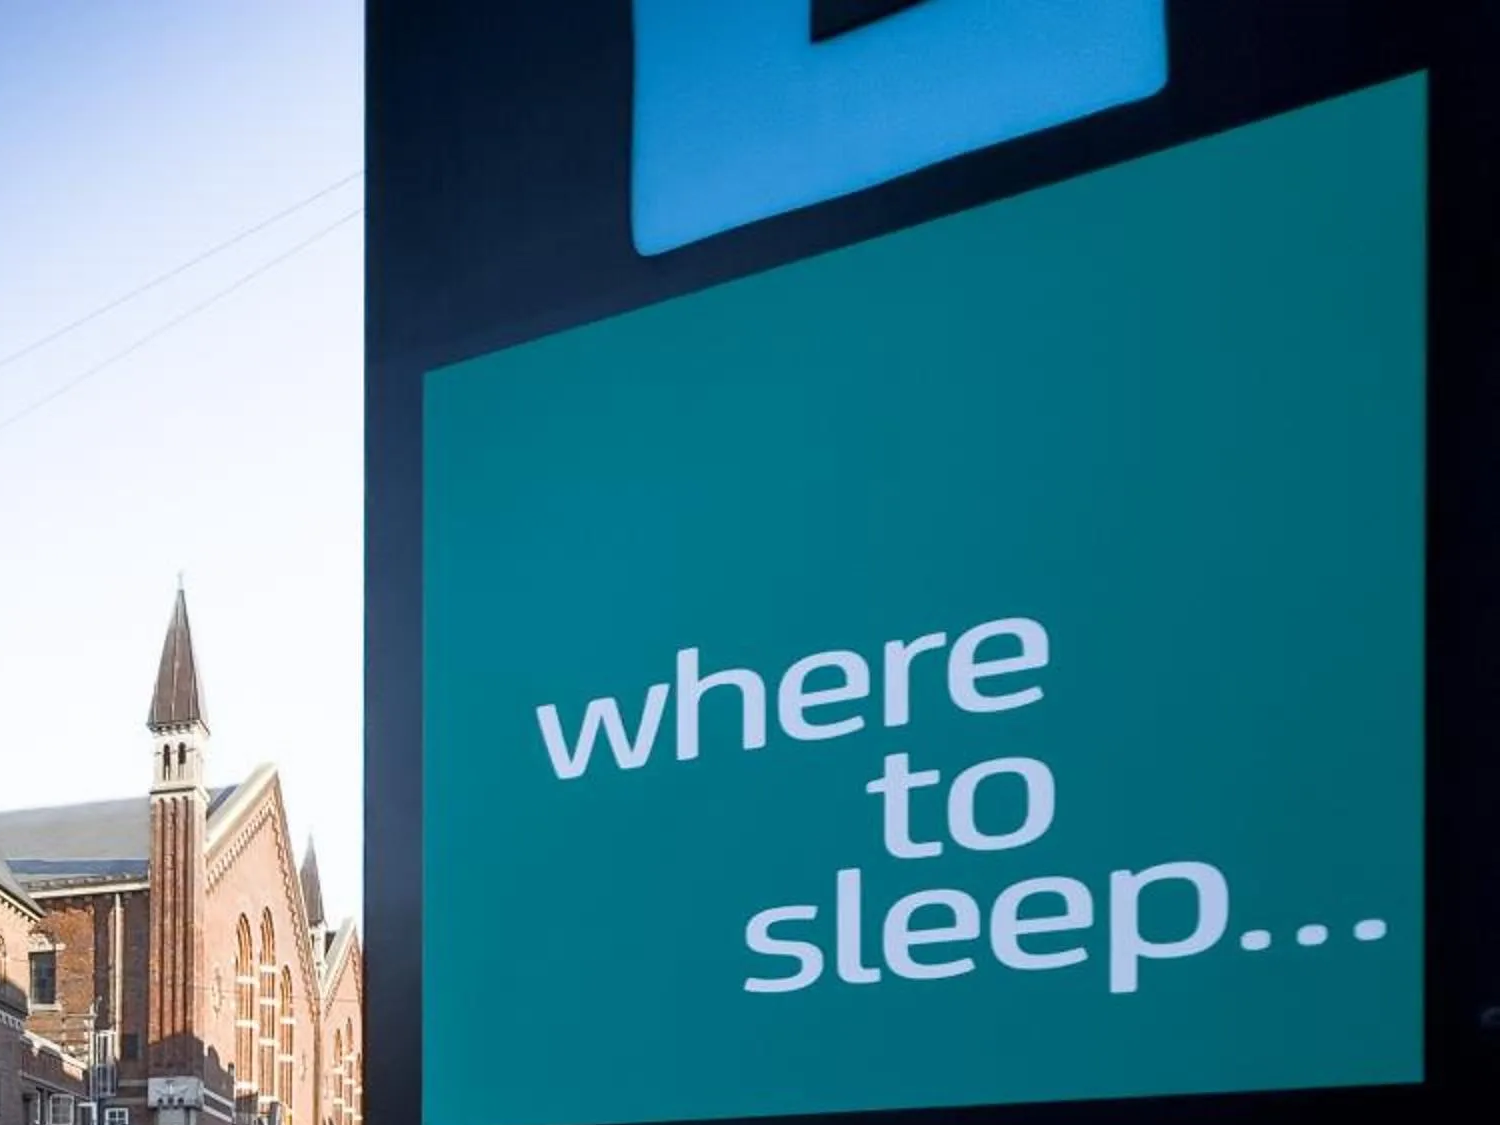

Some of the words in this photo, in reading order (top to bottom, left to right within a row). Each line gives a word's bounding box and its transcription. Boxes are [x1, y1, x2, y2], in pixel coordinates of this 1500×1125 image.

[536, 616, 1050, 779] where
[866, 752, 1056, 859] to
[743, 861, 1386, 993] sleep...
